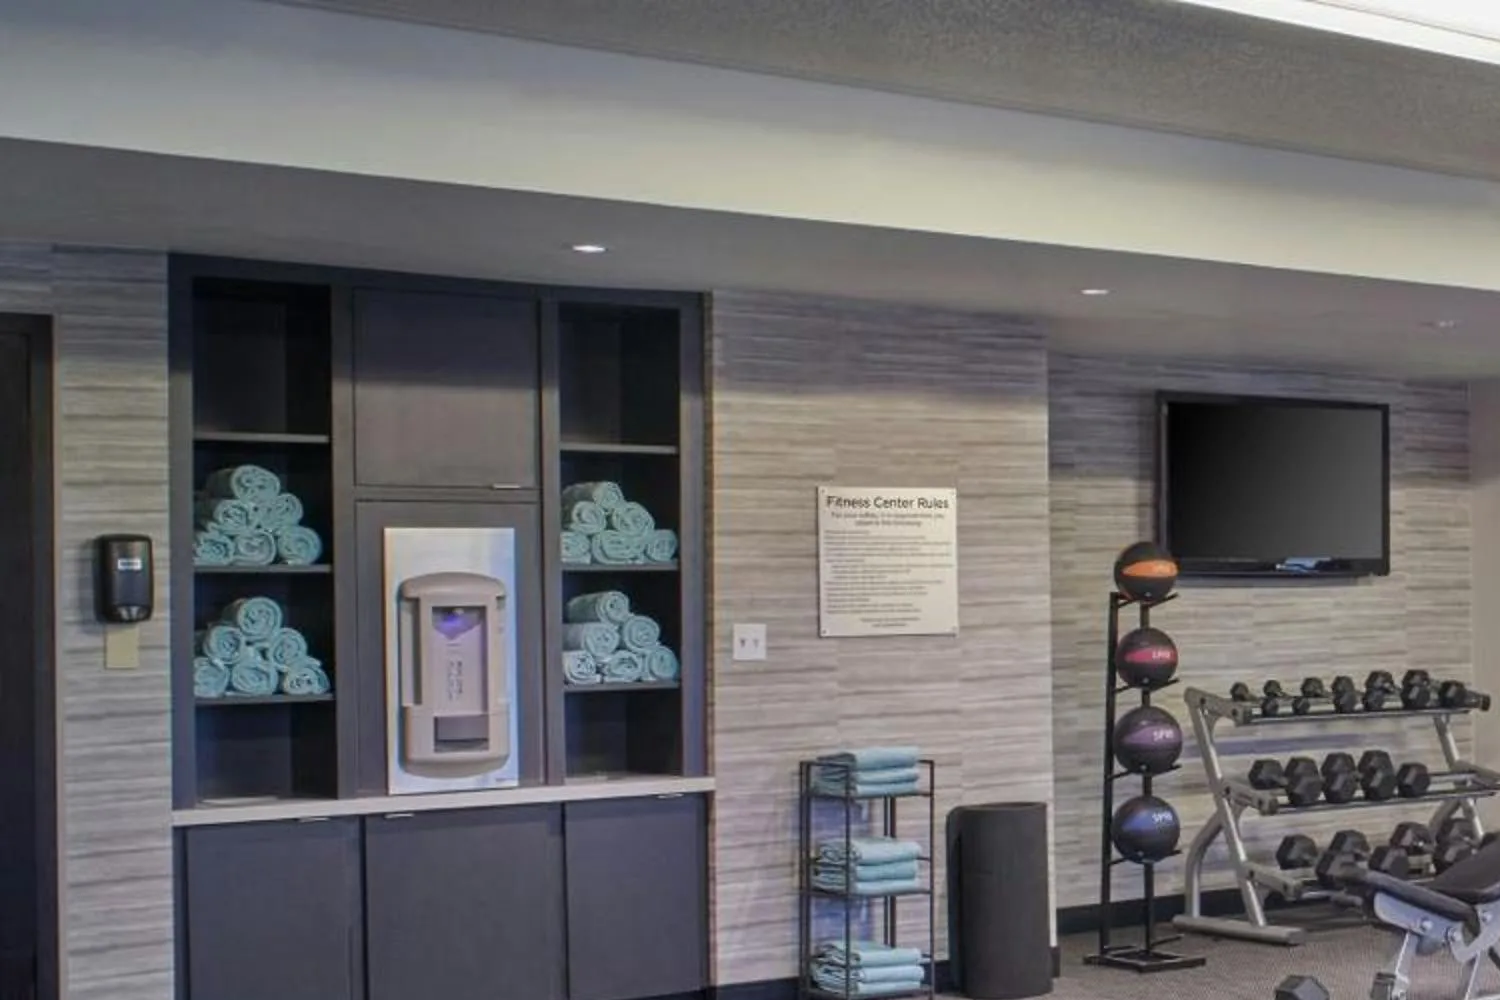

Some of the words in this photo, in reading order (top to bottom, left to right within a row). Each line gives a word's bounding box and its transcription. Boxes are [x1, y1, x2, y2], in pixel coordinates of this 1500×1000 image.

[826, 496, 872, 509] Fitness
[873, 496, 915, 509] Center
[917, 497, 949, 509] Rules
